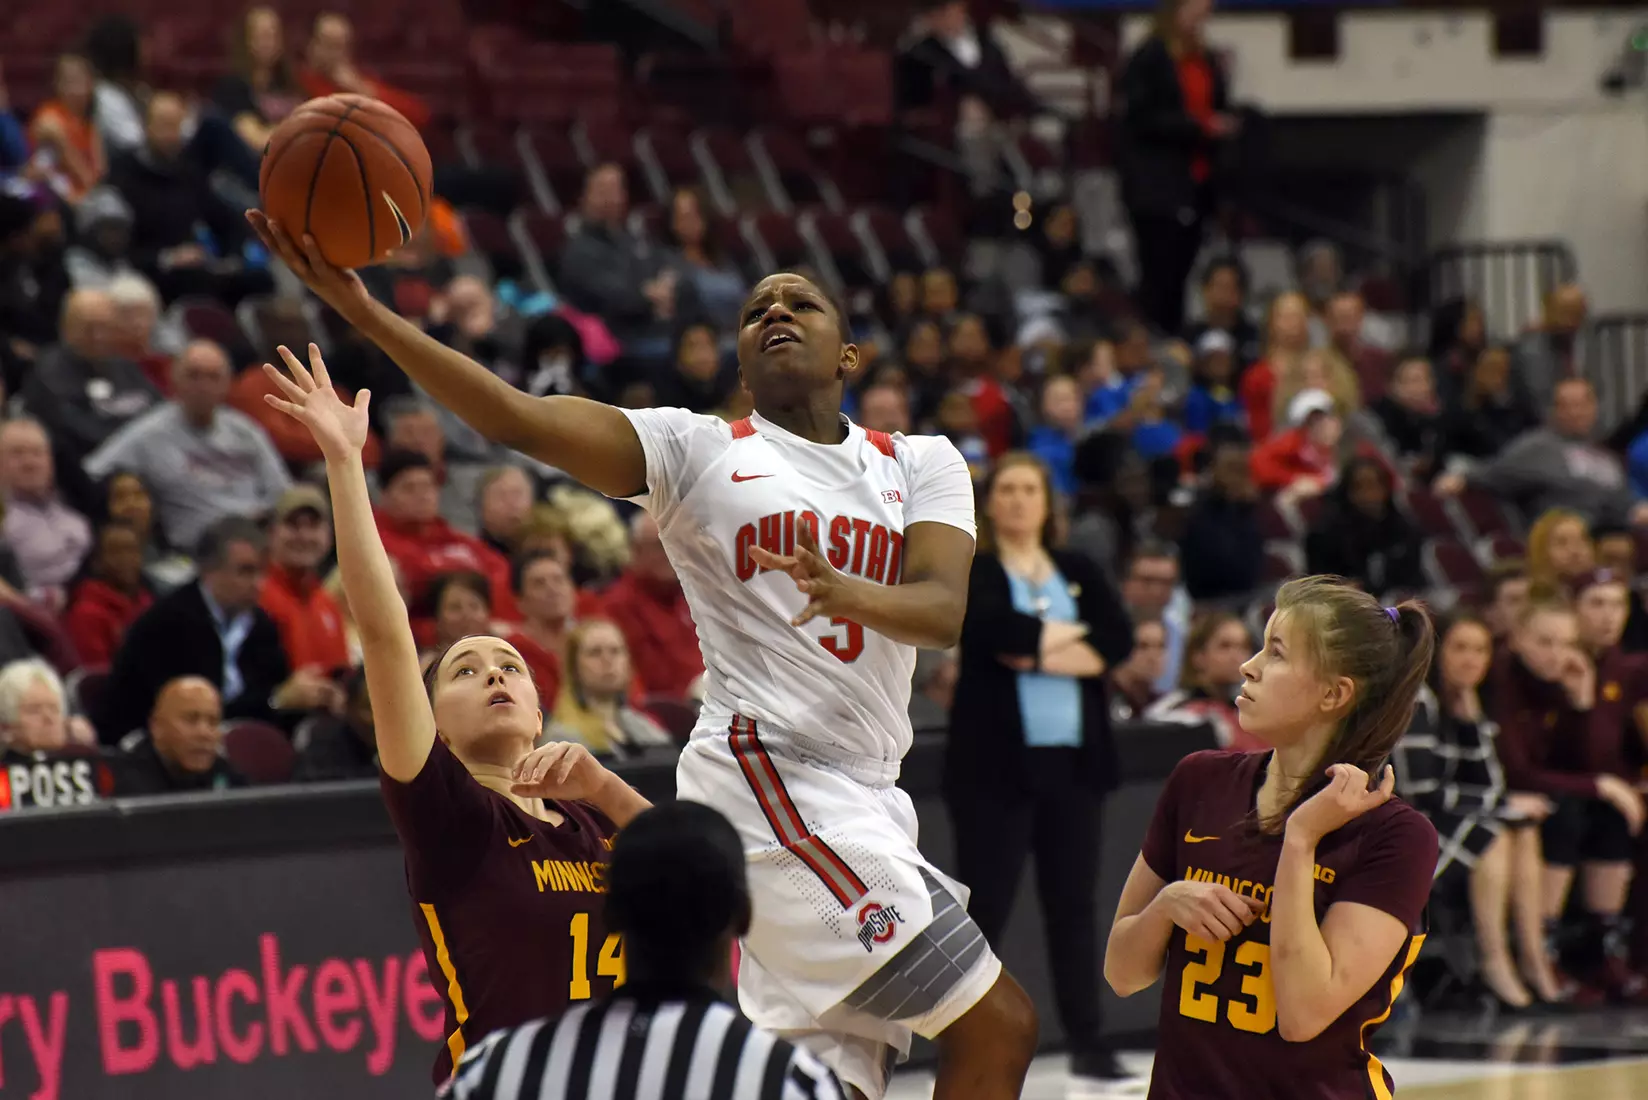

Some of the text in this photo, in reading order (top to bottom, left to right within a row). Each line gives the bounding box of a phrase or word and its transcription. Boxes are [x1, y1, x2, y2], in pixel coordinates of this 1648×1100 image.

[735, 510, 904, 586] OHIO STAT
[9, 761, 95, 811] POSS
[569, 912, 627, 1000] 14
[869, 905, 905, 933] STATE
[92, 932, 445, 1076] Buckeye
[1179, 932, 1277, 1034] 23
